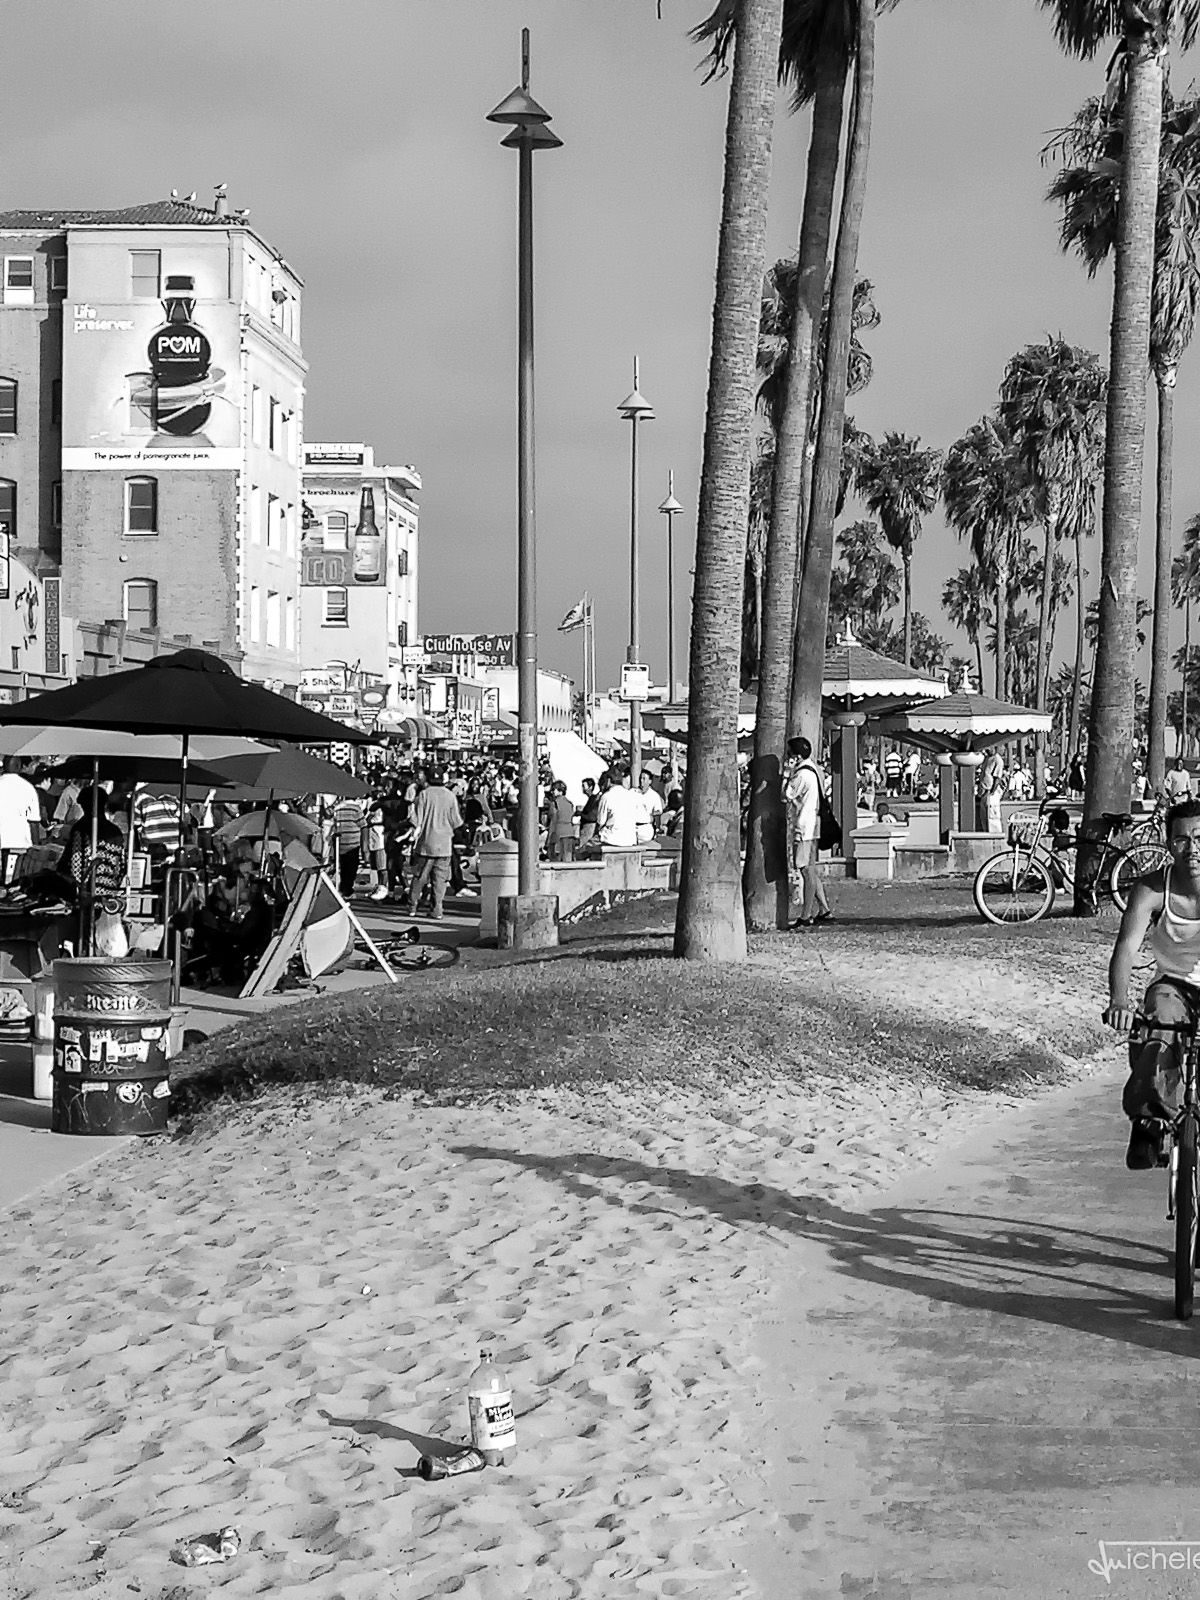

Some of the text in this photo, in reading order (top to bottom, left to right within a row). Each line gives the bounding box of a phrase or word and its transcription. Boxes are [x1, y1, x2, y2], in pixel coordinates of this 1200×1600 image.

[73, 303, 97, 319] Life
[134, 451, 141, 459] of
[143, 452, 191, 461] pomegranate
[425, 638, 511, 652] Clubhouse Av
